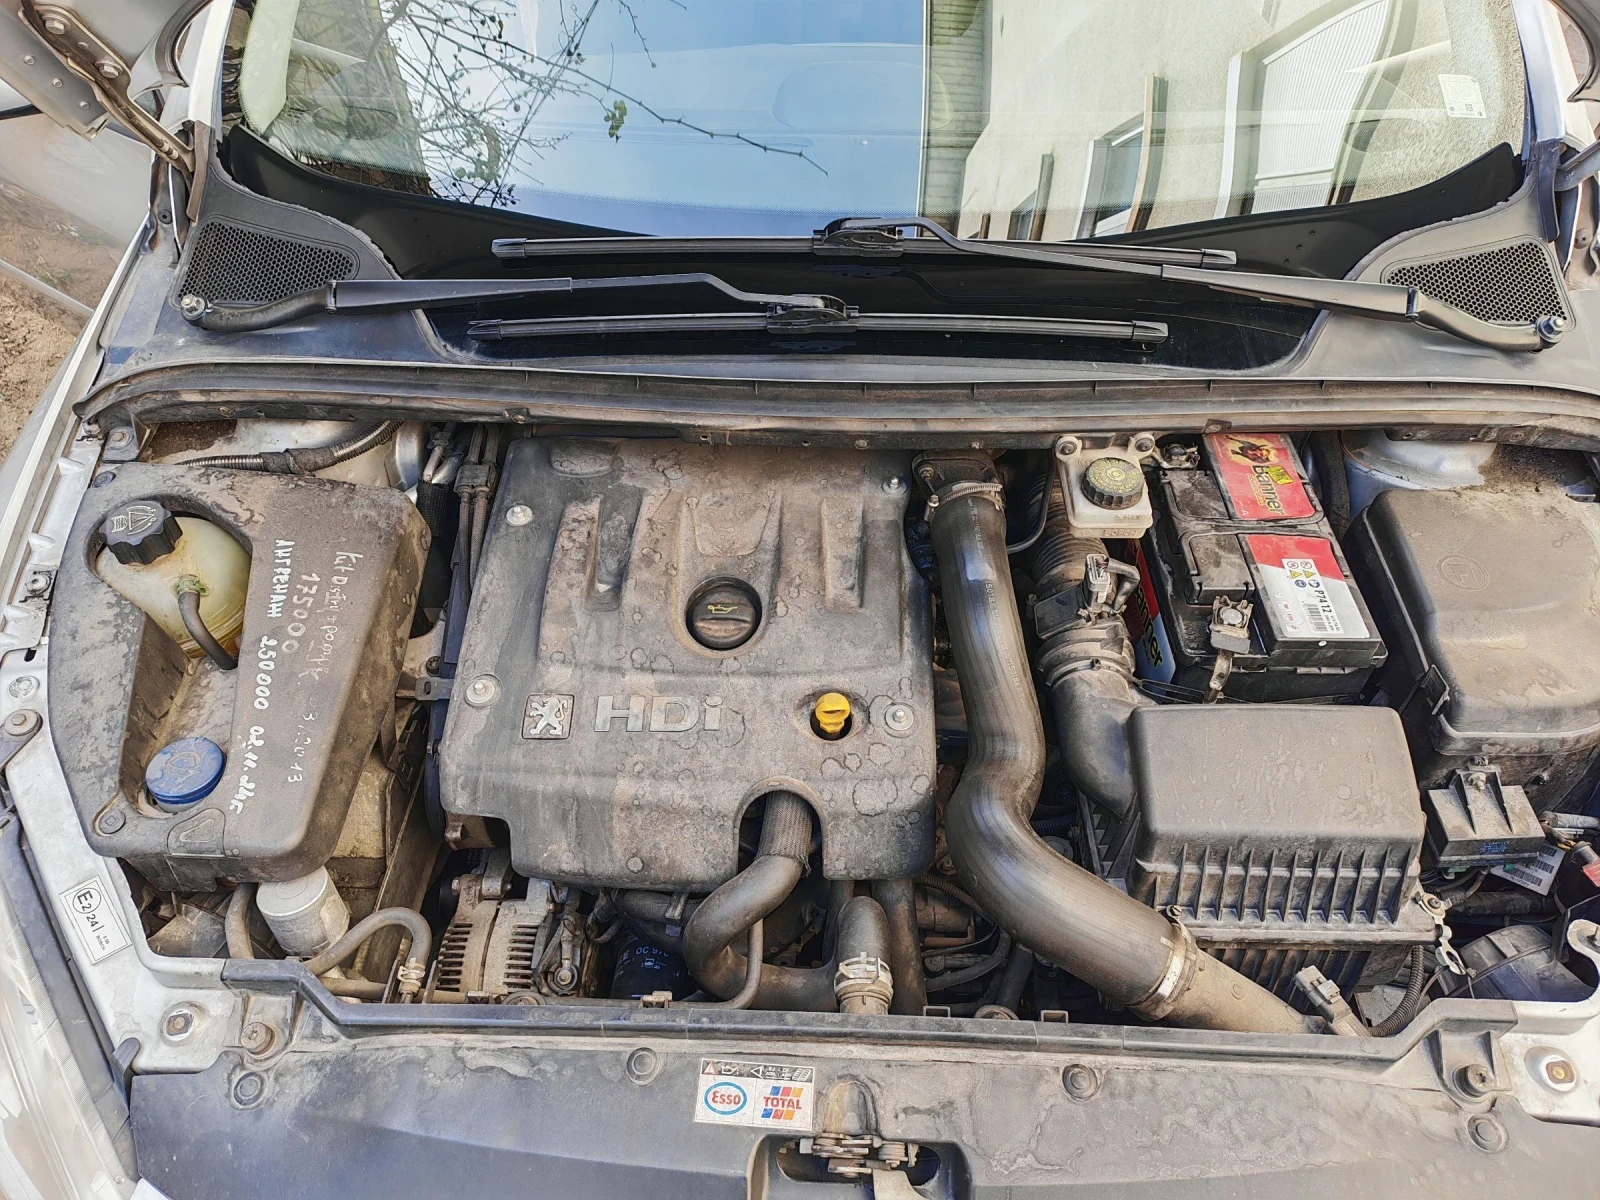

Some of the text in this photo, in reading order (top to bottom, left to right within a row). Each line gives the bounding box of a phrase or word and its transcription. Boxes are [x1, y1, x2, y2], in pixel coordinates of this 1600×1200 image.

[1252, 464, 1286, 515] Banner
[1136, 585, 1163, 668] anner
[594, 694, 723, 733] HDi
[763, 1096, 803, 1111] TOTAL
